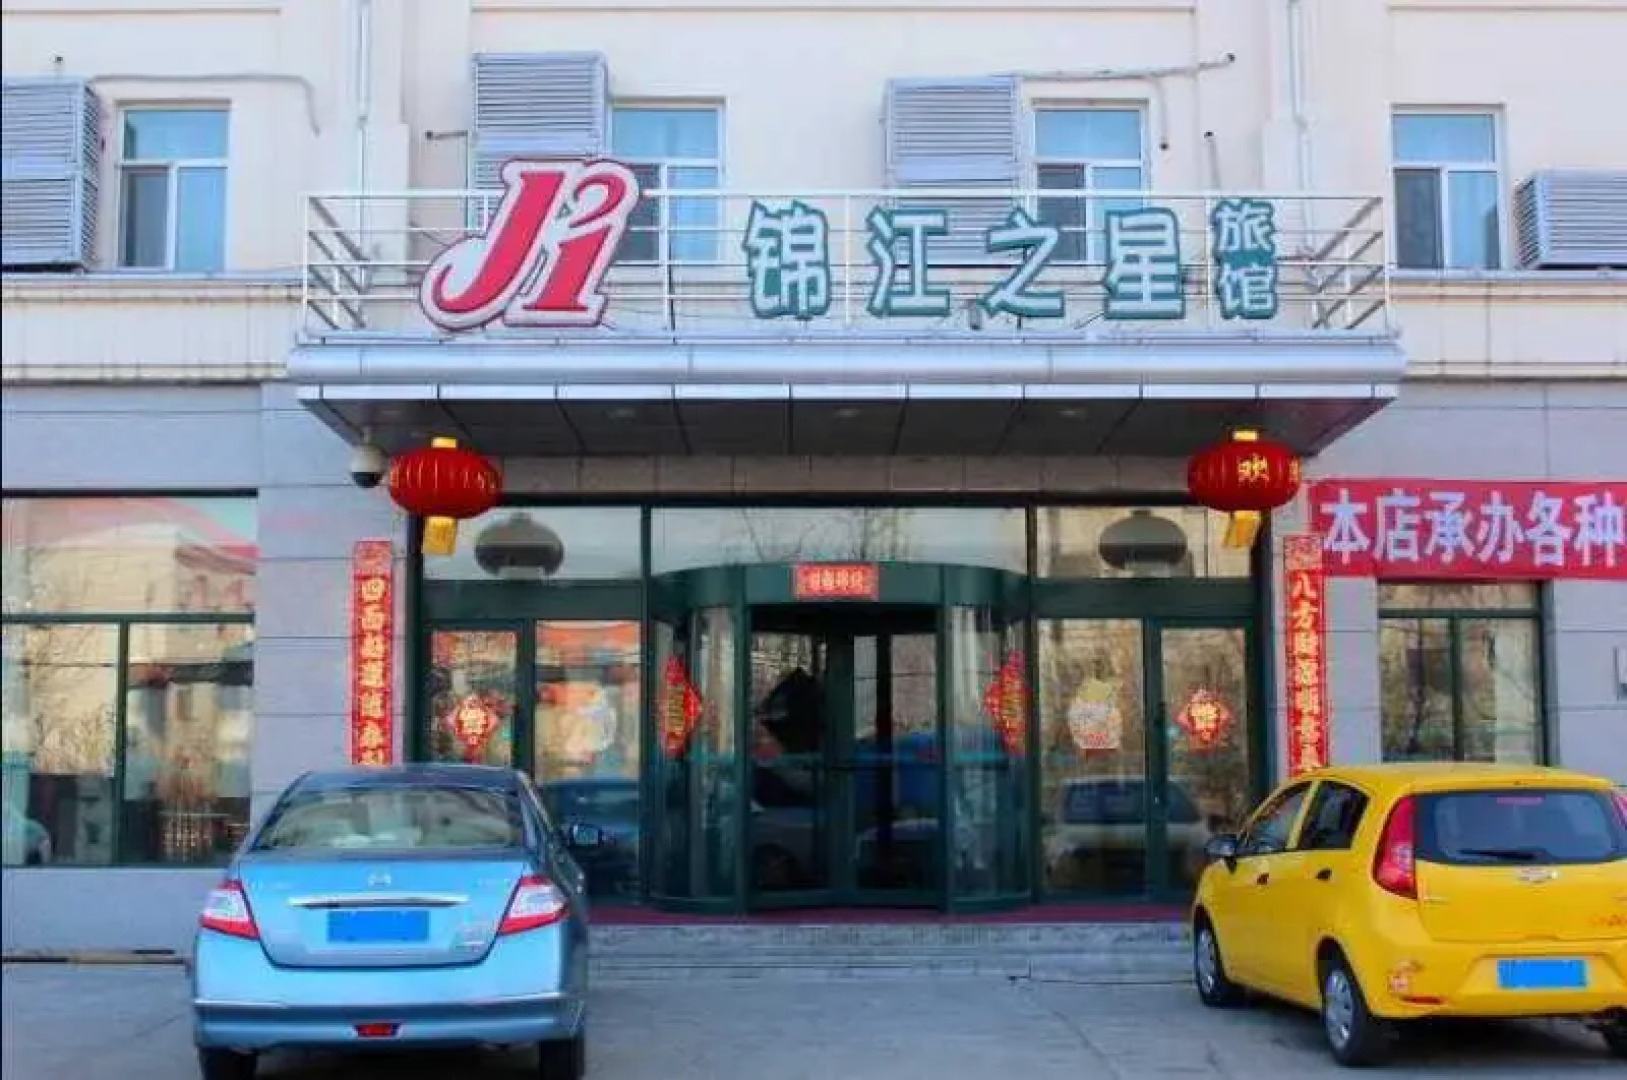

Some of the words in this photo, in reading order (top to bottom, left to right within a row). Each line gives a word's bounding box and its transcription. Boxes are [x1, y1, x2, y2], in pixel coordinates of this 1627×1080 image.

[745, 200, 1184, 319] 锦江之星
[1212, 200, 1277, 319] 旅馆
[1320, 487, 1624, 567] 本店承办各种
